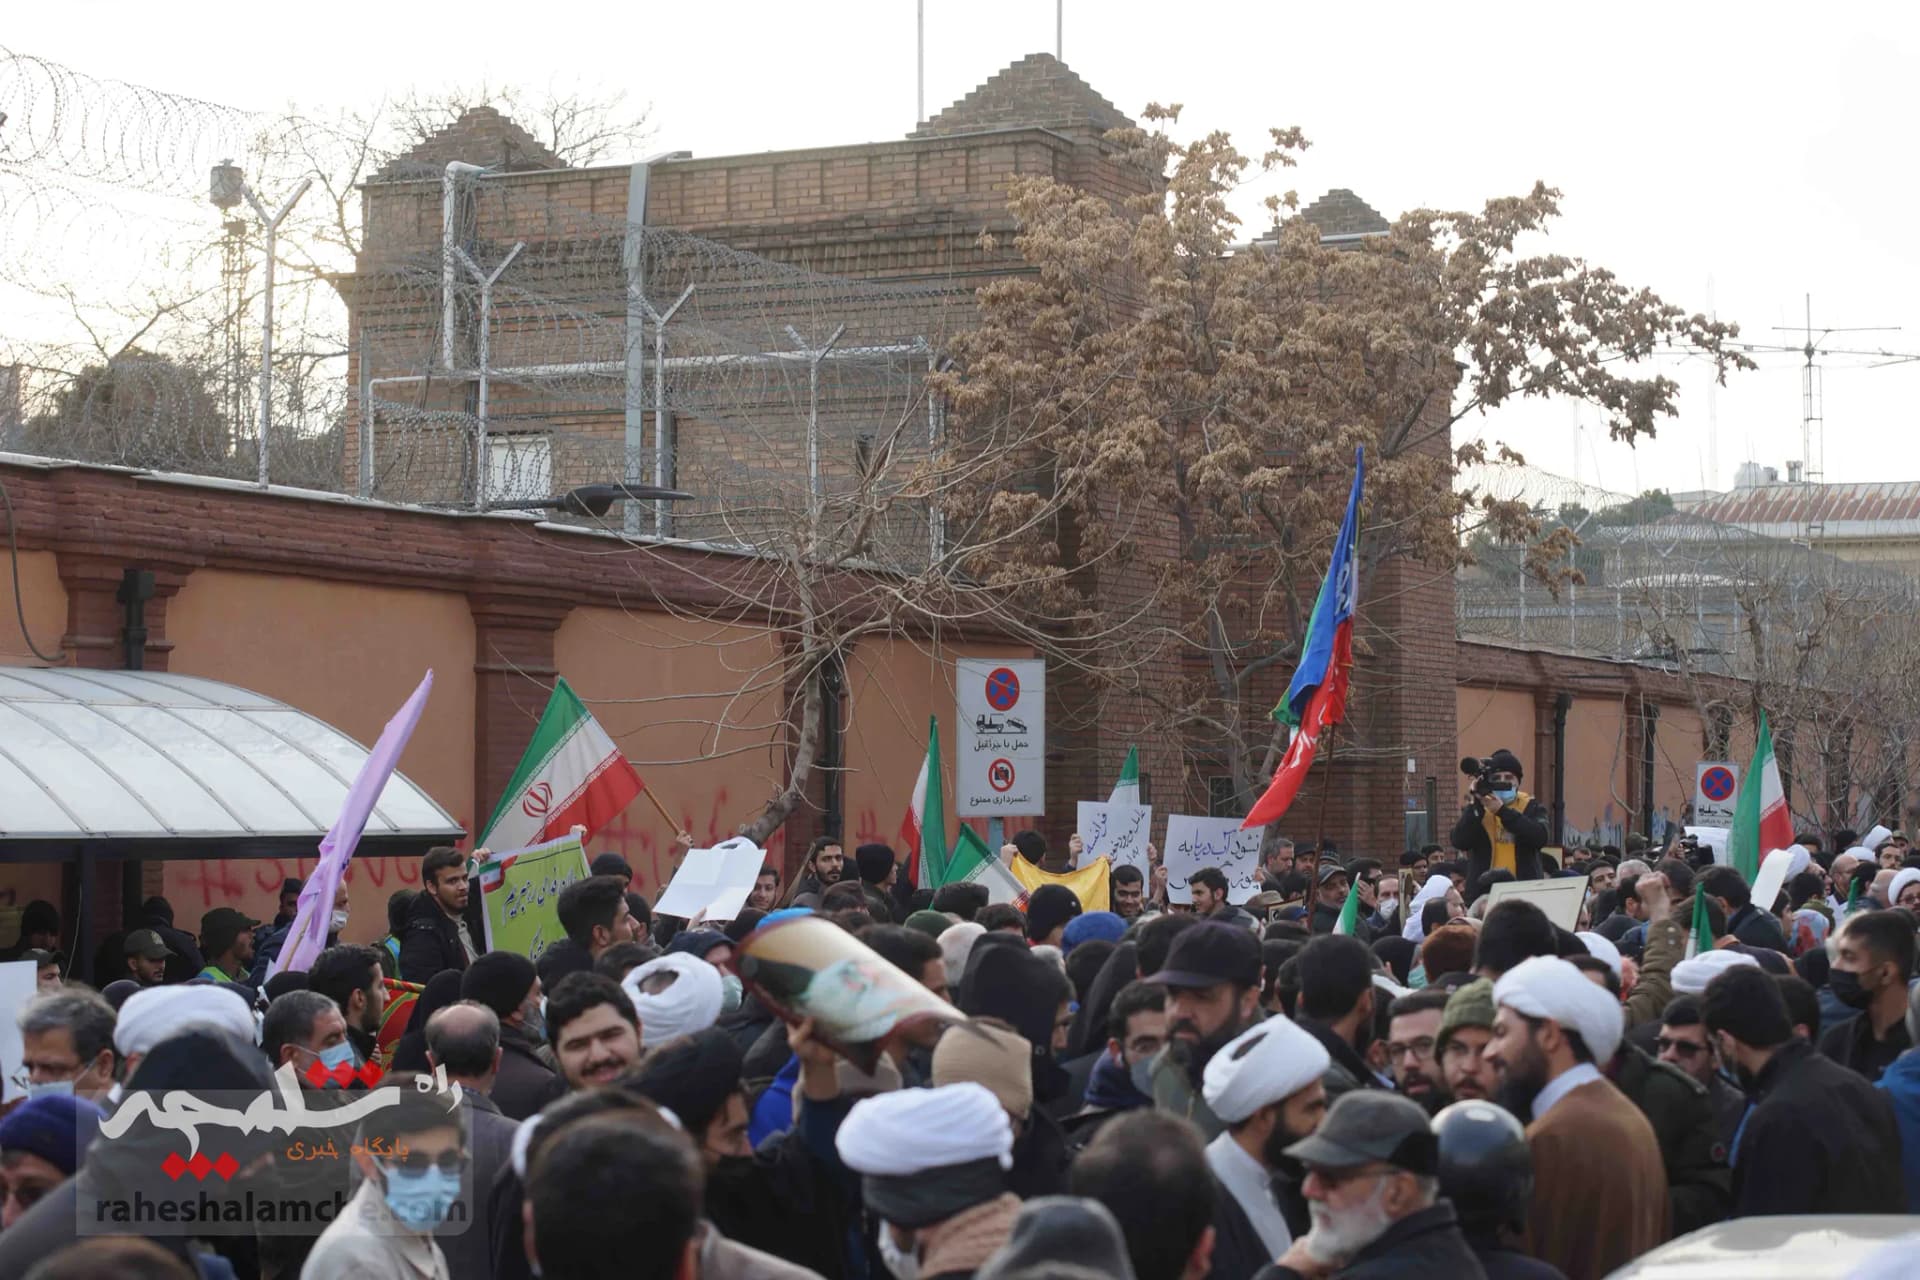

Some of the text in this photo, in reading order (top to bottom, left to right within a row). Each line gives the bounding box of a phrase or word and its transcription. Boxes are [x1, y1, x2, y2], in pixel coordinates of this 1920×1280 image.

[974, 737, 1029, 752] حمل با جرثقیل
[969, 796, 991, 807] ممنوع
[1178, 839, 1193, 857] به
[1212, 828, 1237, 860] آب
[1230, 834, 1260, 860] نشود
